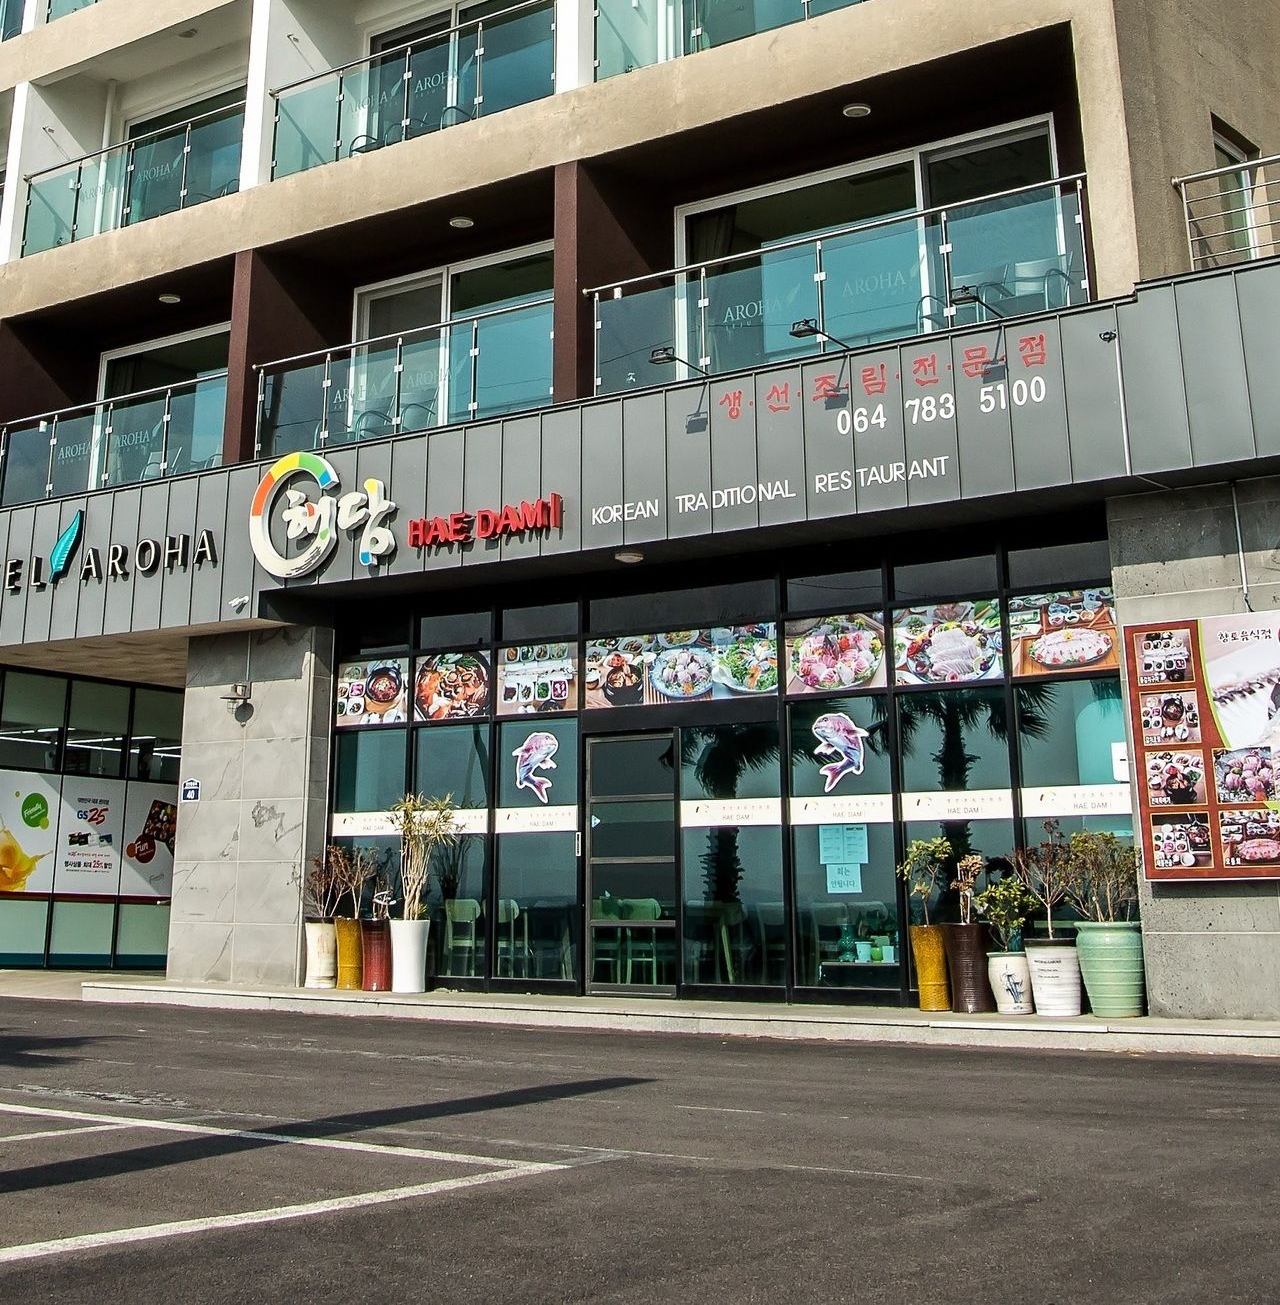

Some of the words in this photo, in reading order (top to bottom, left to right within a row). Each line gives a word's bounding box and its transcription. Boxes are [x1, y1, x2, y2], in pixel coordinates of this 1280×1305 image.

[842, 270, 906, 296] AROHA
[836, 403, 888, 435] 064
[904, 392, 955, 425] 783
[979, 375, 1046, 413] 5100
[591, 499, 659, 526] KOREAN
[675, 479, 796, 514] TRADITIONAL
[815, 455, 949, 494] RESTAURANT
[407, 510, 472, 548] HAE
[79, 528, 217, 583] AROHA
[1218, 628, 1272, 643] 향토음식점
[186, 790, 195, 800] 40
[24, 802, 43, 818] Friendly
[77, 807, 109, 825] GS25
[135, 840, 149, 854] Fun
